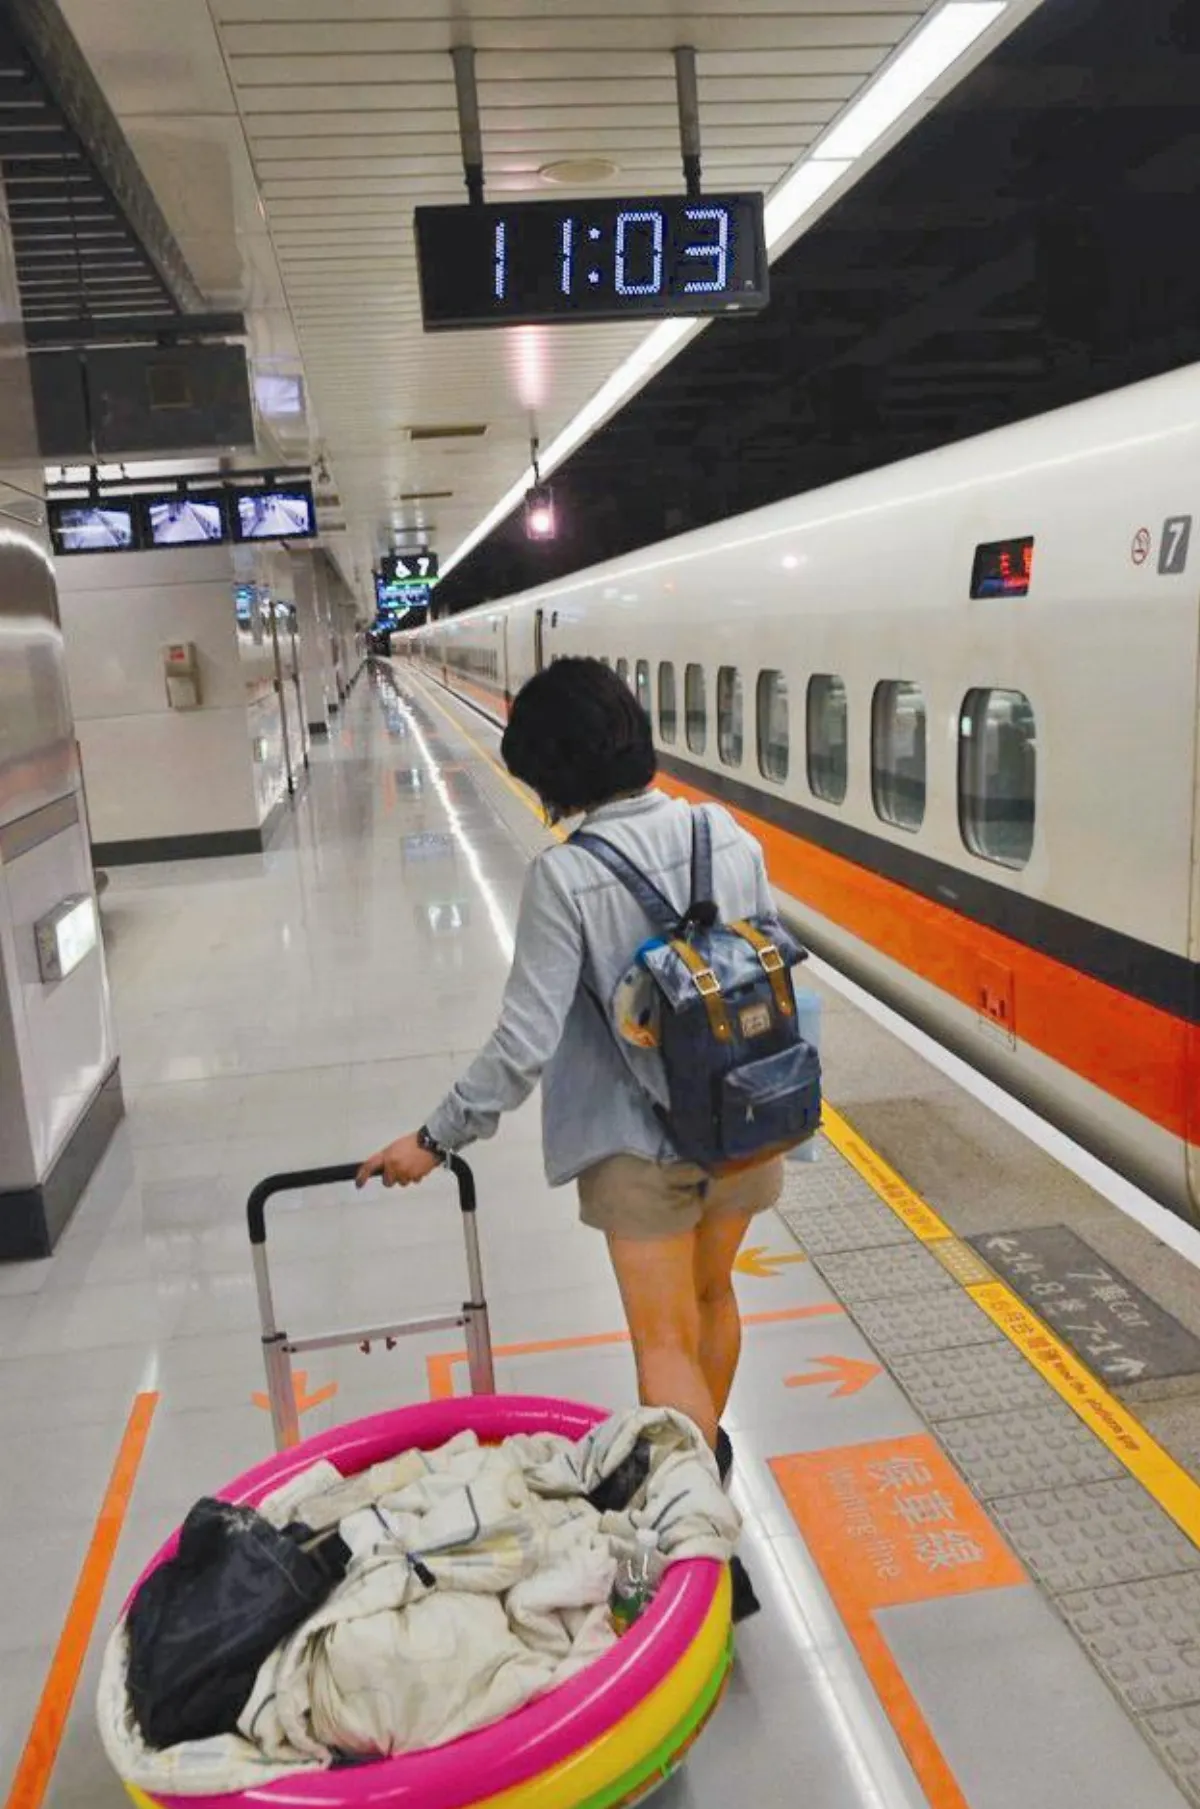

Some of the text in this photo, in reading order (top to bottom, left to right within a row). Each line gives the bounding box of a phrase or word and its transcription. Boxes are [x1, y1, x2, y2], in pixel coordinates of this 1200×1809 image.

[495, 209, 728, 299] 11:03
[417, 557, 430, 576] 7
[1165, 522, 1184, 567] 7
[864, 1455, 985, 1573] 候車線
